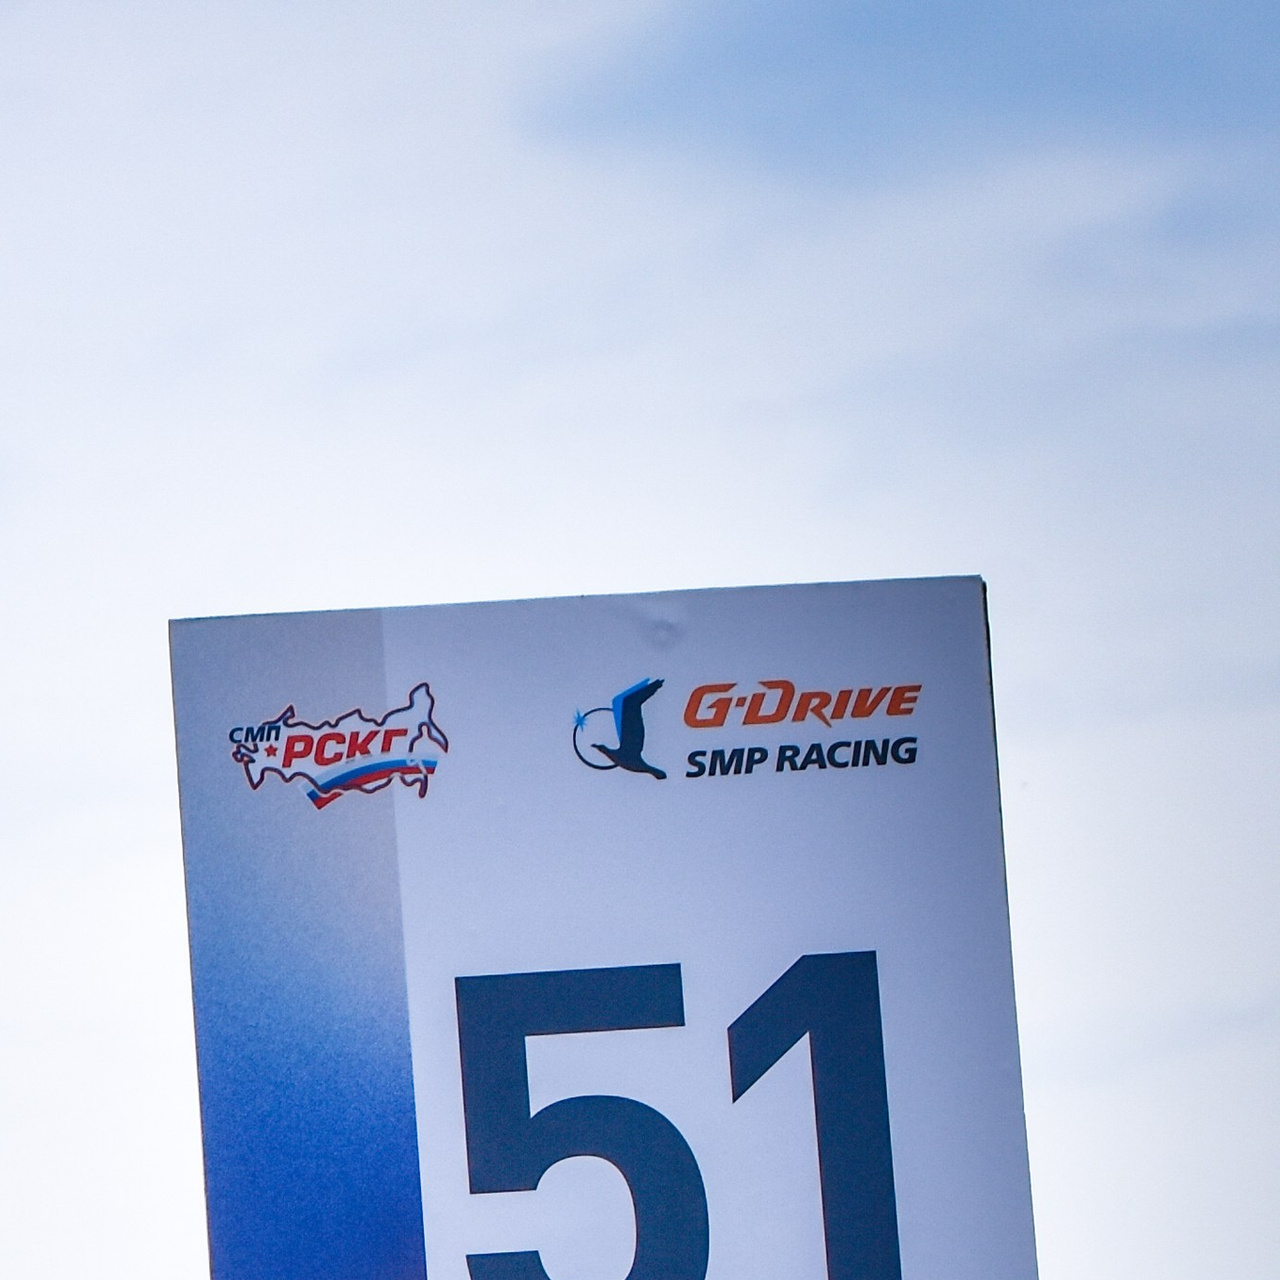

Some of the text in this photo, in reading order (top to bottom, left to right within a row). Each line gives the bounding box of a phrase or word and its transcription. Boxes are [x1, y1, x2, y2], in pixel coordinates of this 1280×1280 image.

[228, 725, 282, 744] СМП
[282, 728, 408, 768] РСКГ
[685, 736, 918, 778] SMP RACING
